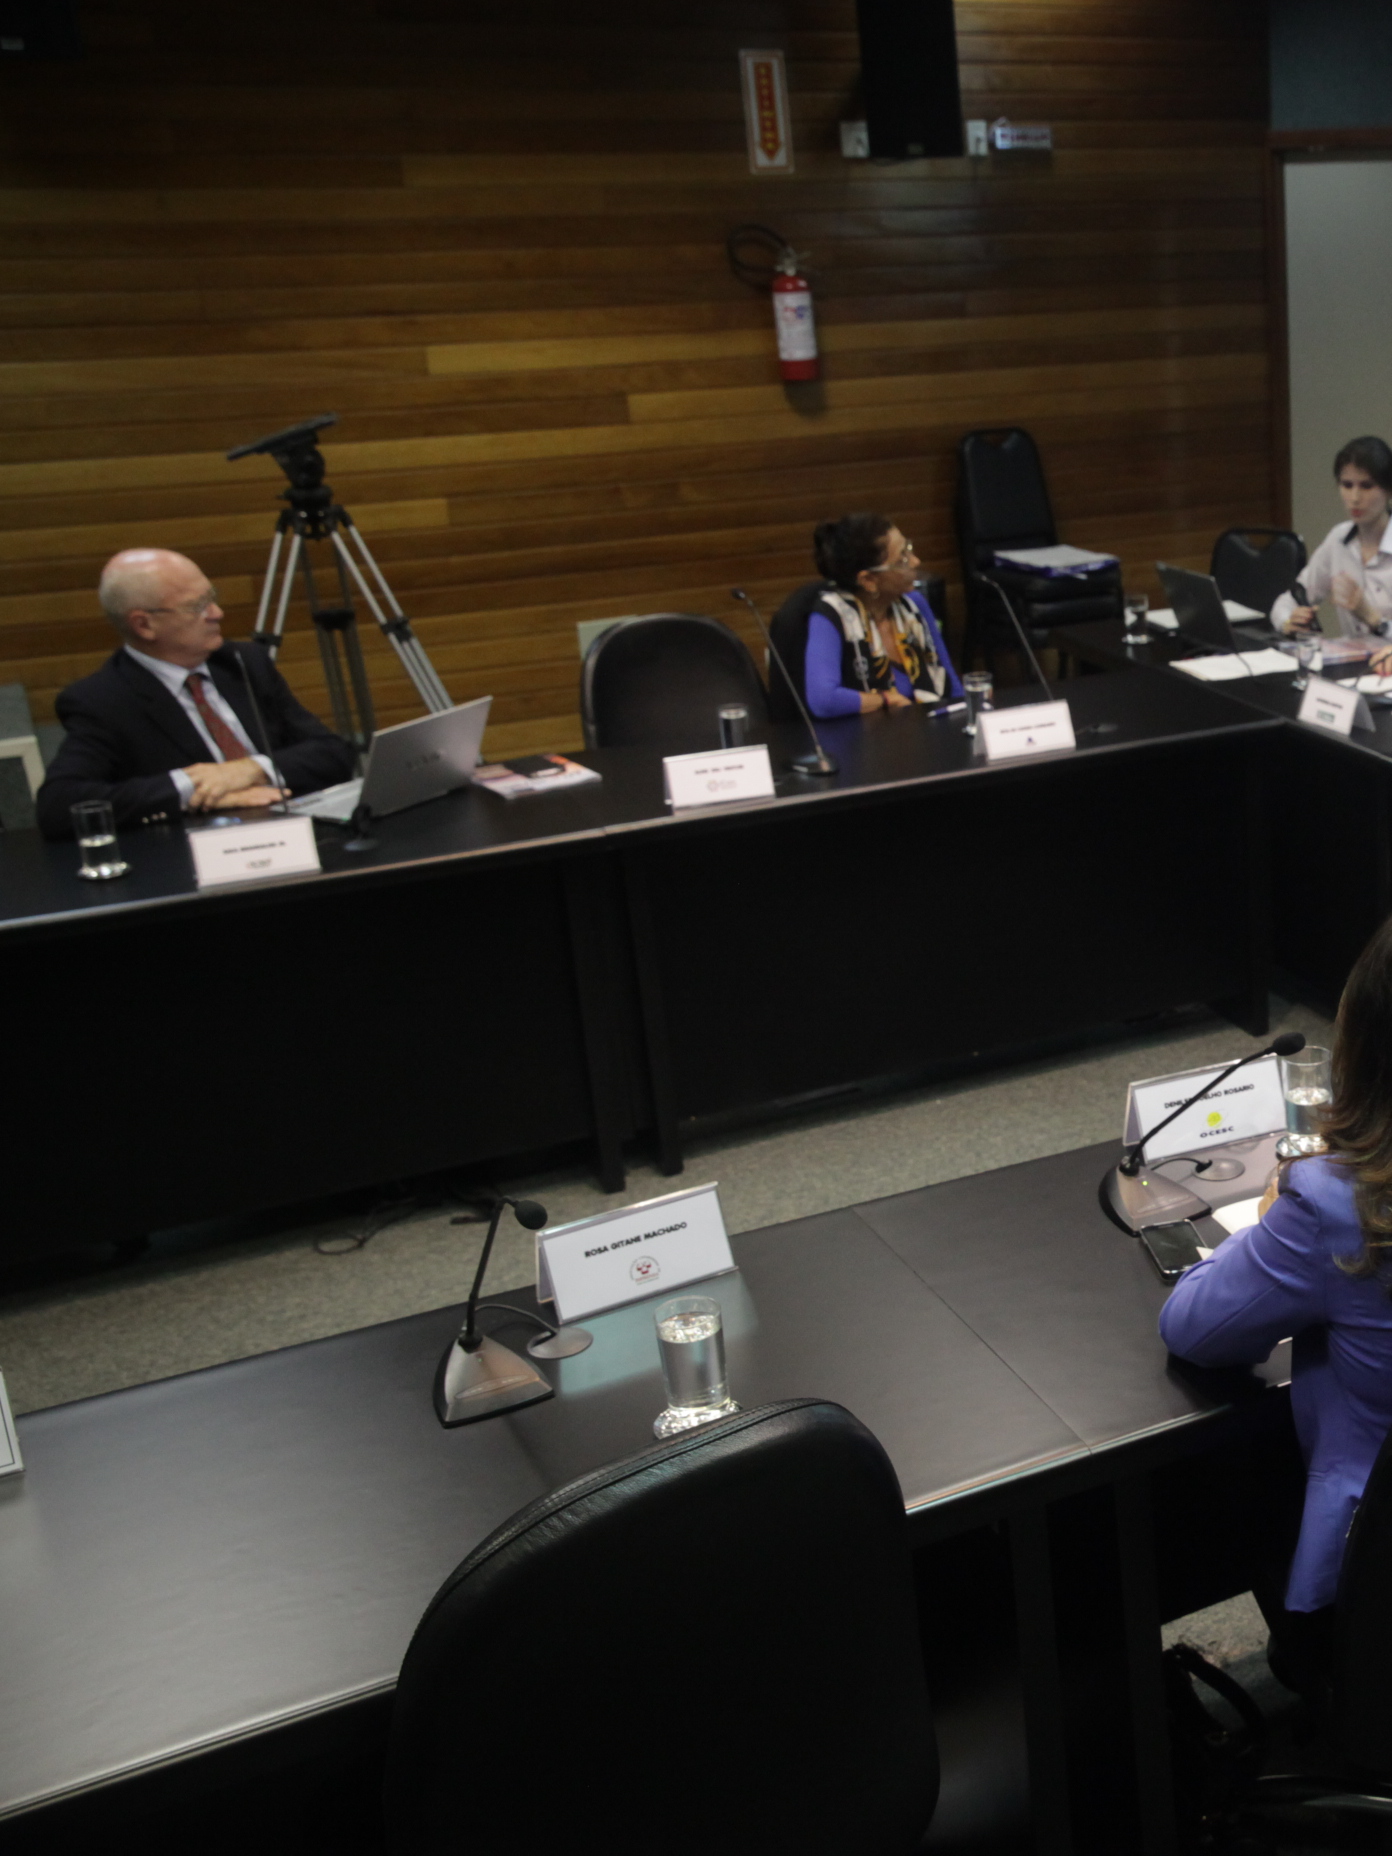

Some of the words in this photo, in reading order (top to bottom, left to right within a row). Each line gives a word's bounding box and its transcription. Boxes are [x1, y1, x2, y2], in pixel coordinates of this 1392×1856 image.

[1224, 1084, 1254, 1096] ROSARIO
[1200, 1126, 1234, 1138] OCESC
[584, 1245, 609, 1258] ROSA
[611, 1235, 641, 1250] GITANE
[644, 1222, 687, 1240] MACHADO
